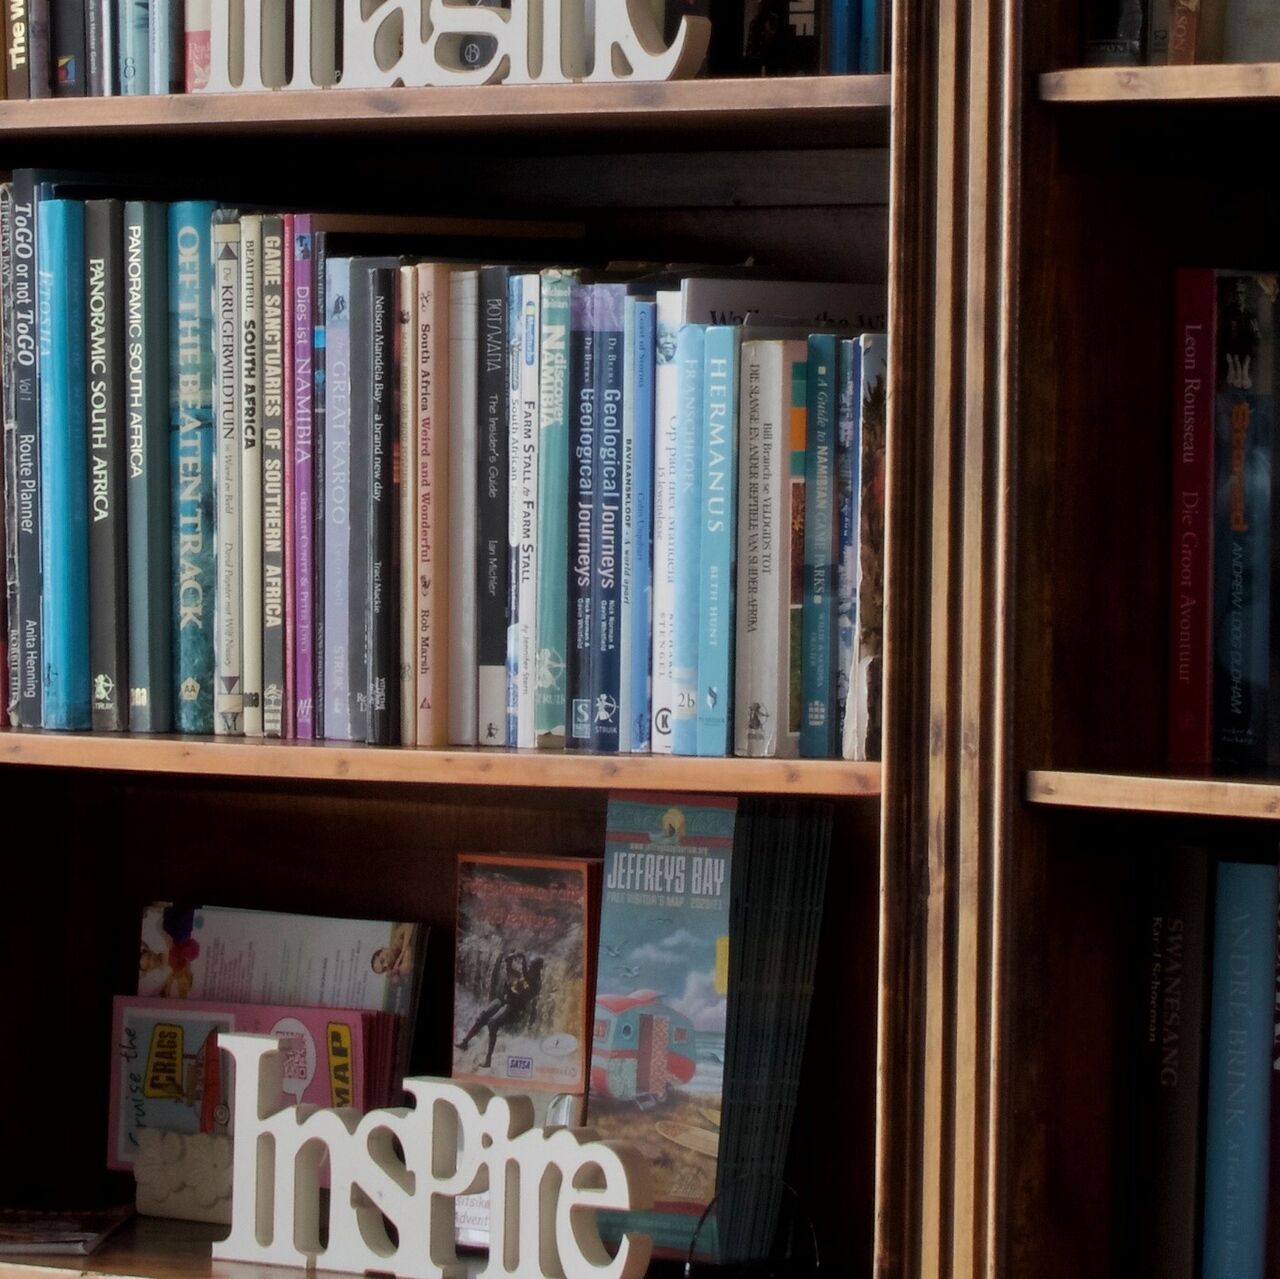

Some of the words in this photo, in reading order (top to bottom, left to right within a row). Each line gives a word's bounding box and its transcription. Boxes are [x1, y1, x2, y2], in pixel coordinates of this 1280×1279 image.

[9, 23, 26, 69] The
[264, 236, 280, 286] GAME
[90, 258, 107, 374] PANORAMIC
[264, 295, 281, 417] SANCTUARIES
[91, 381, 106, 449] SOUTH
[264, 429, 280, 451] OF
[296, 357, 312, 464] NAMIBIA
[598, 388, 620, 497] Geological
[708, 358, 725, 532] HERMANUS
[92, 457, 109, 521] AFRICA
[265, 459, 281, 552] SOUTHERN
[598, 502, 620, 588] Journeys
[265, 565, 281, 628] AFRICA
[606, 852, 685, 894] JEFFREYS
[690, 859, 725, 897] BAY
